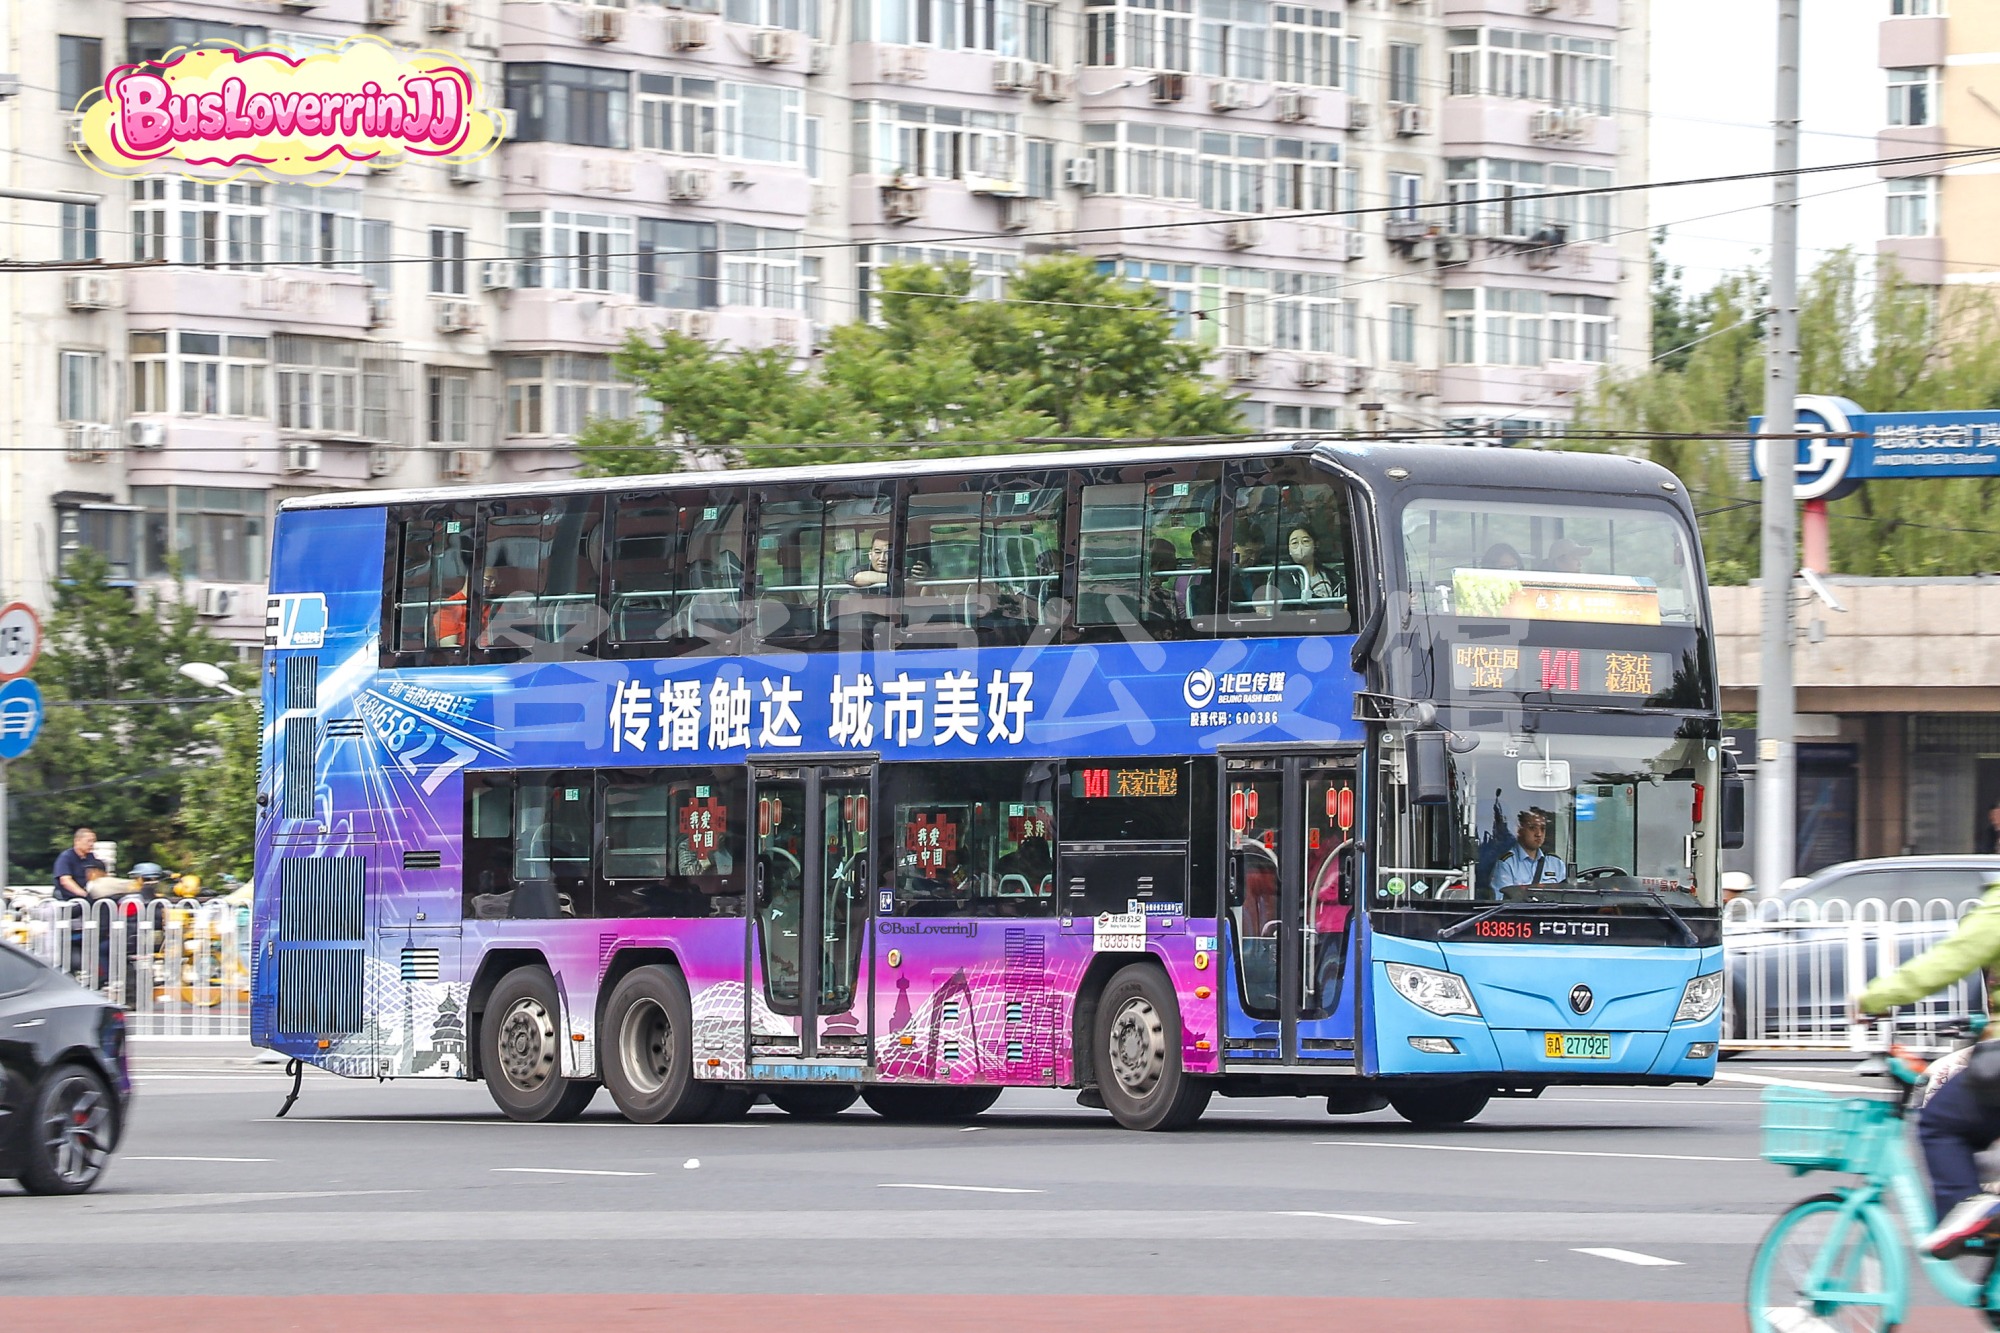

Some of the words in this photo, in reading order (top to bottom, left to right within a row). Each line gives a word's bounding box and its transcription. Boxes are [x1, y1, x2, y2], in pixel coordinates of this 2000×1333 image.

[1456, 646, 1520, 669] 时代庄园
[1605, 652, 1653, 674] 宋家庄
[1471, 668, 1503, 688] 北站
[1538, 648, 1580, 691] 141
[1218, 671, 1286, 693] 北巴传媒
[1605, 673, 1653, 695] 枢纽站
[1243, 694, 1261, 703] BASHI
[1263, 693, 1283, 702] MEDIA
[609, 675, 803, 752] 传播触达
[828, 669, 1035, 748] 城市美好
[1082, 769, 1109, 798] 141
[692, 829, 714, 848] 中国
[920, 848, 943, 866] 中国
[1111, 915, 1142, 923] 北京公交
[1539, 921, 1610, 936] FOTON
[1475, 921, 1532, 938] 1838515
[1100, 934, 1142, 949] 1838515
